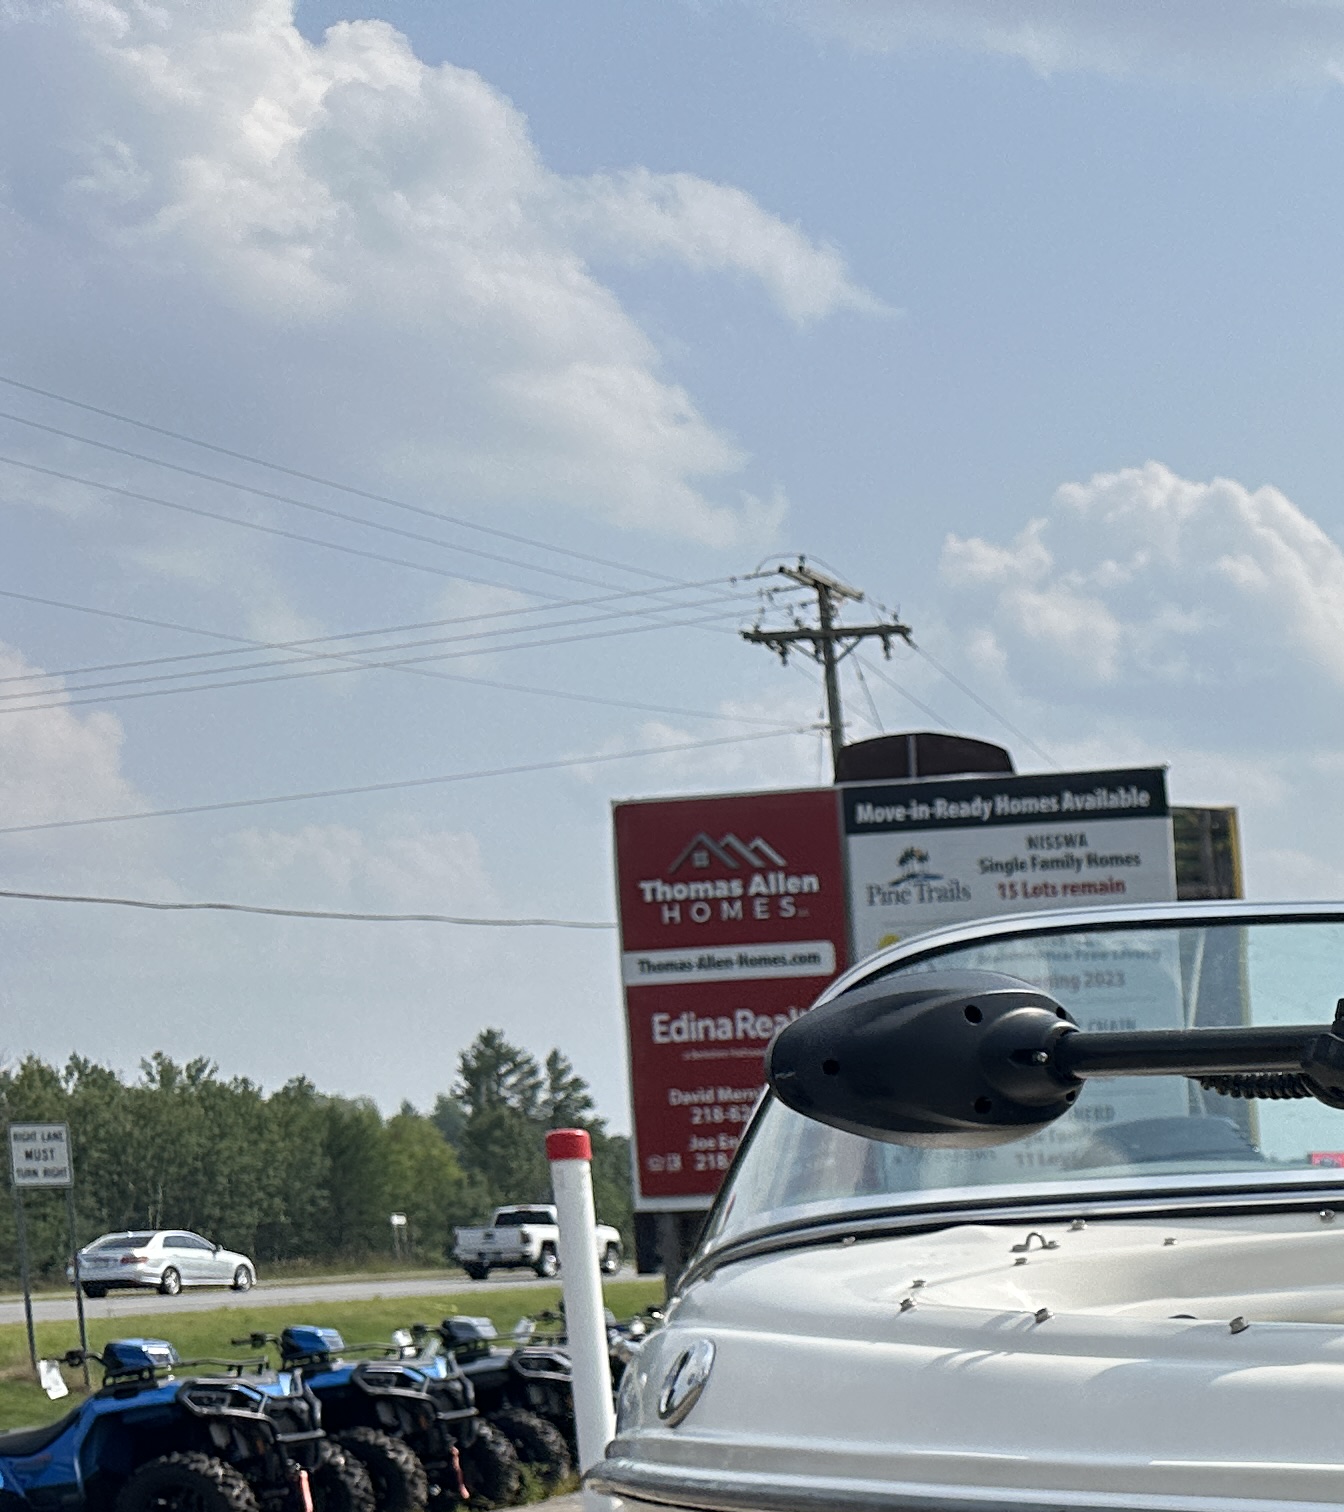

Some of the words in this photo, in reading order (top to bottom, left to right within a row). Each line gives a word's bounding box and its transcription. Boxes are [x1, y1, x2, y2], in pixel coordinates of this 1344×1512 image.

[856, 797, 992, 823] Move-in-Ready
[996, 794, 1059, 816] Homes
[1062, 786, 1150, 812] Available
[1026, 832, 1088, 850] NISSWA
[978, 858, 1027, 876] Single
[1031, 854, 1083, 874] Family
[1086, 851, 1141, 868] Homes
[638, 878, 744, 903] Thomas
[747, 870, 820, 896] Allen
[866, 884, 911, 906] Pine
[915, 879, 971, 902] Trails
[998, 882, 1018, 899] 15
[1021, 880, 1057, 898] Lots
[1062, 876, 1126, 896] remain
[661, 896, 797, 924] HOMES
[637, 952, 821, 974] Thomas-Allen-Homes.com
[669, 1086, 714, 1105] David
[25, 1147, 55, 1161] MUST
[689, 1134, 716, 1151] Joe
